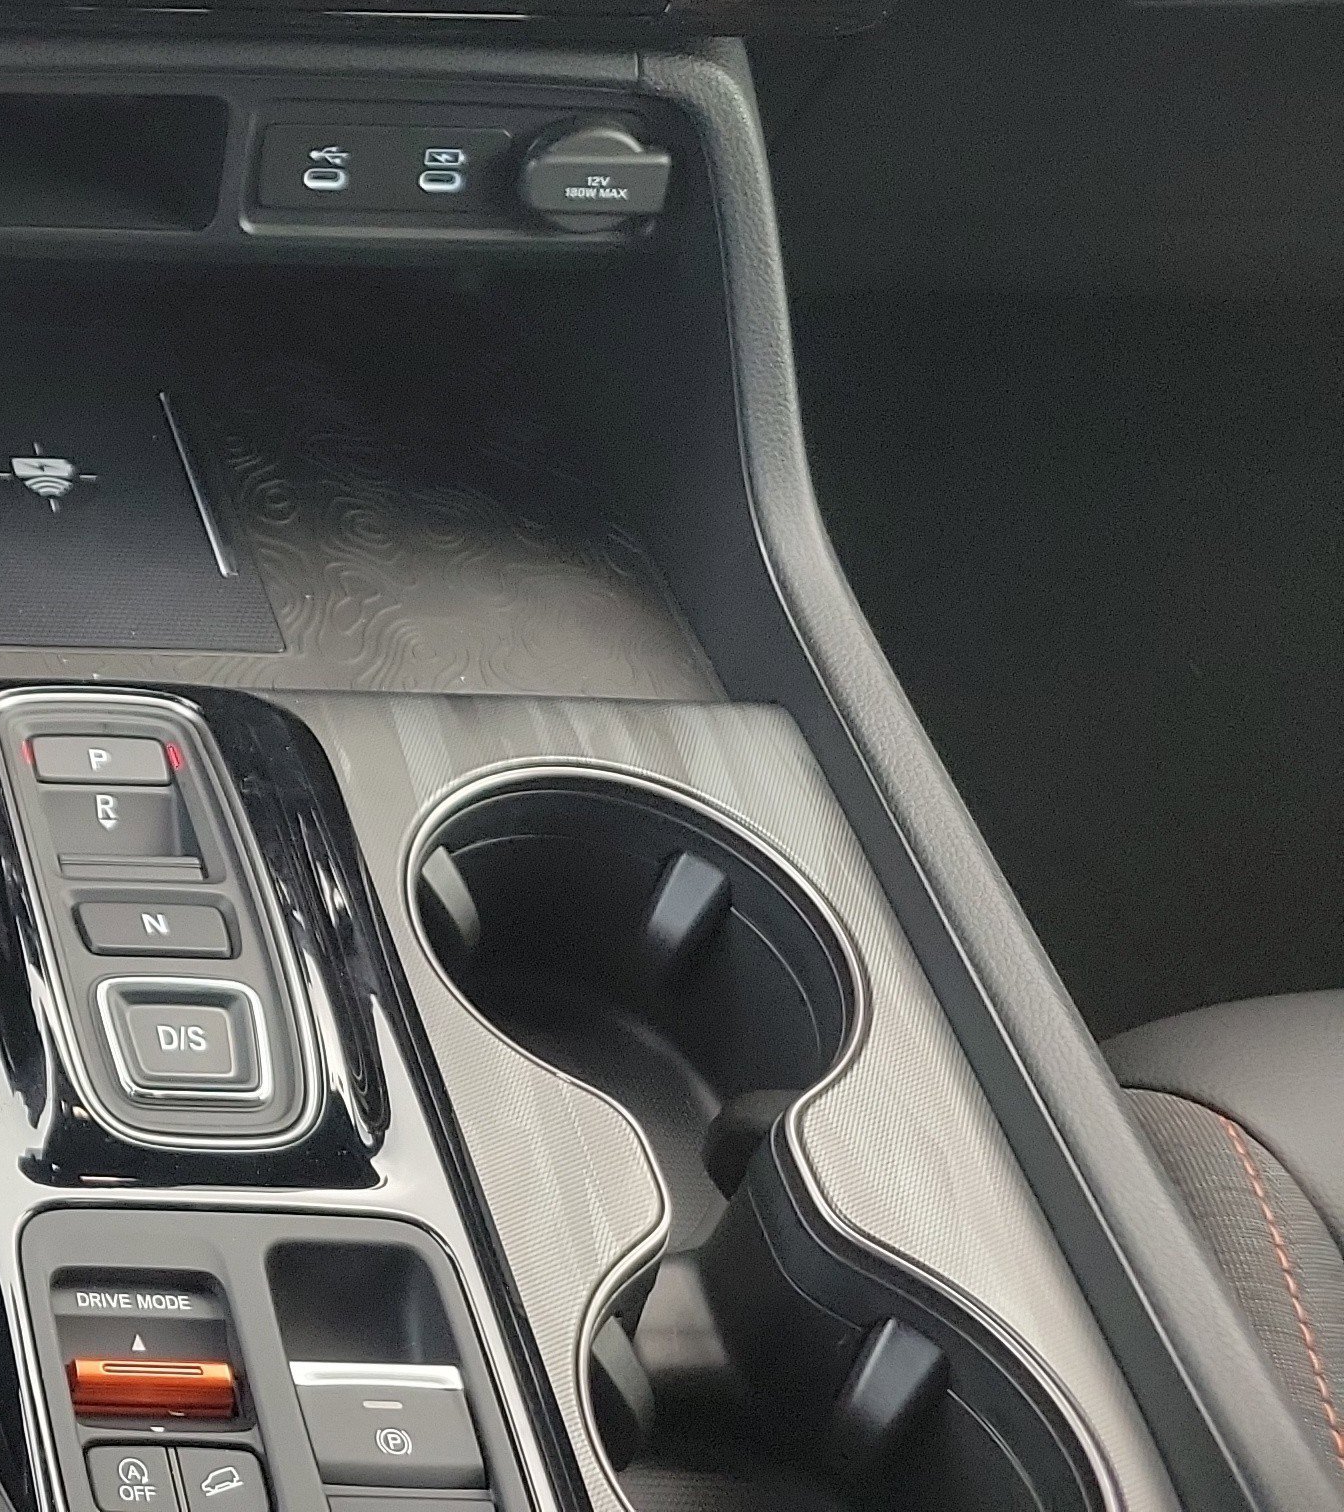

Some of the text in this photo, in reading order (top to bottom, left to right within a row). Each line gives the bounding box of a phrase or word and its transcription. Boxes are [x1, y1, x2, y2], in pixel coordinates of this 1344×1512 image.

[587, 176, 610, 187] 12V
[599, 188, 628, 200] MAX
[88, 748, 108, 770] P
[96, 795, 118, 818] R
[142, 914, 168, 934] N
[157, 1025, 207, 1052] D/S
[77, 1292, 192, 1311] DRIVE MODE
[119, 1485, 156, 1502] OFF
